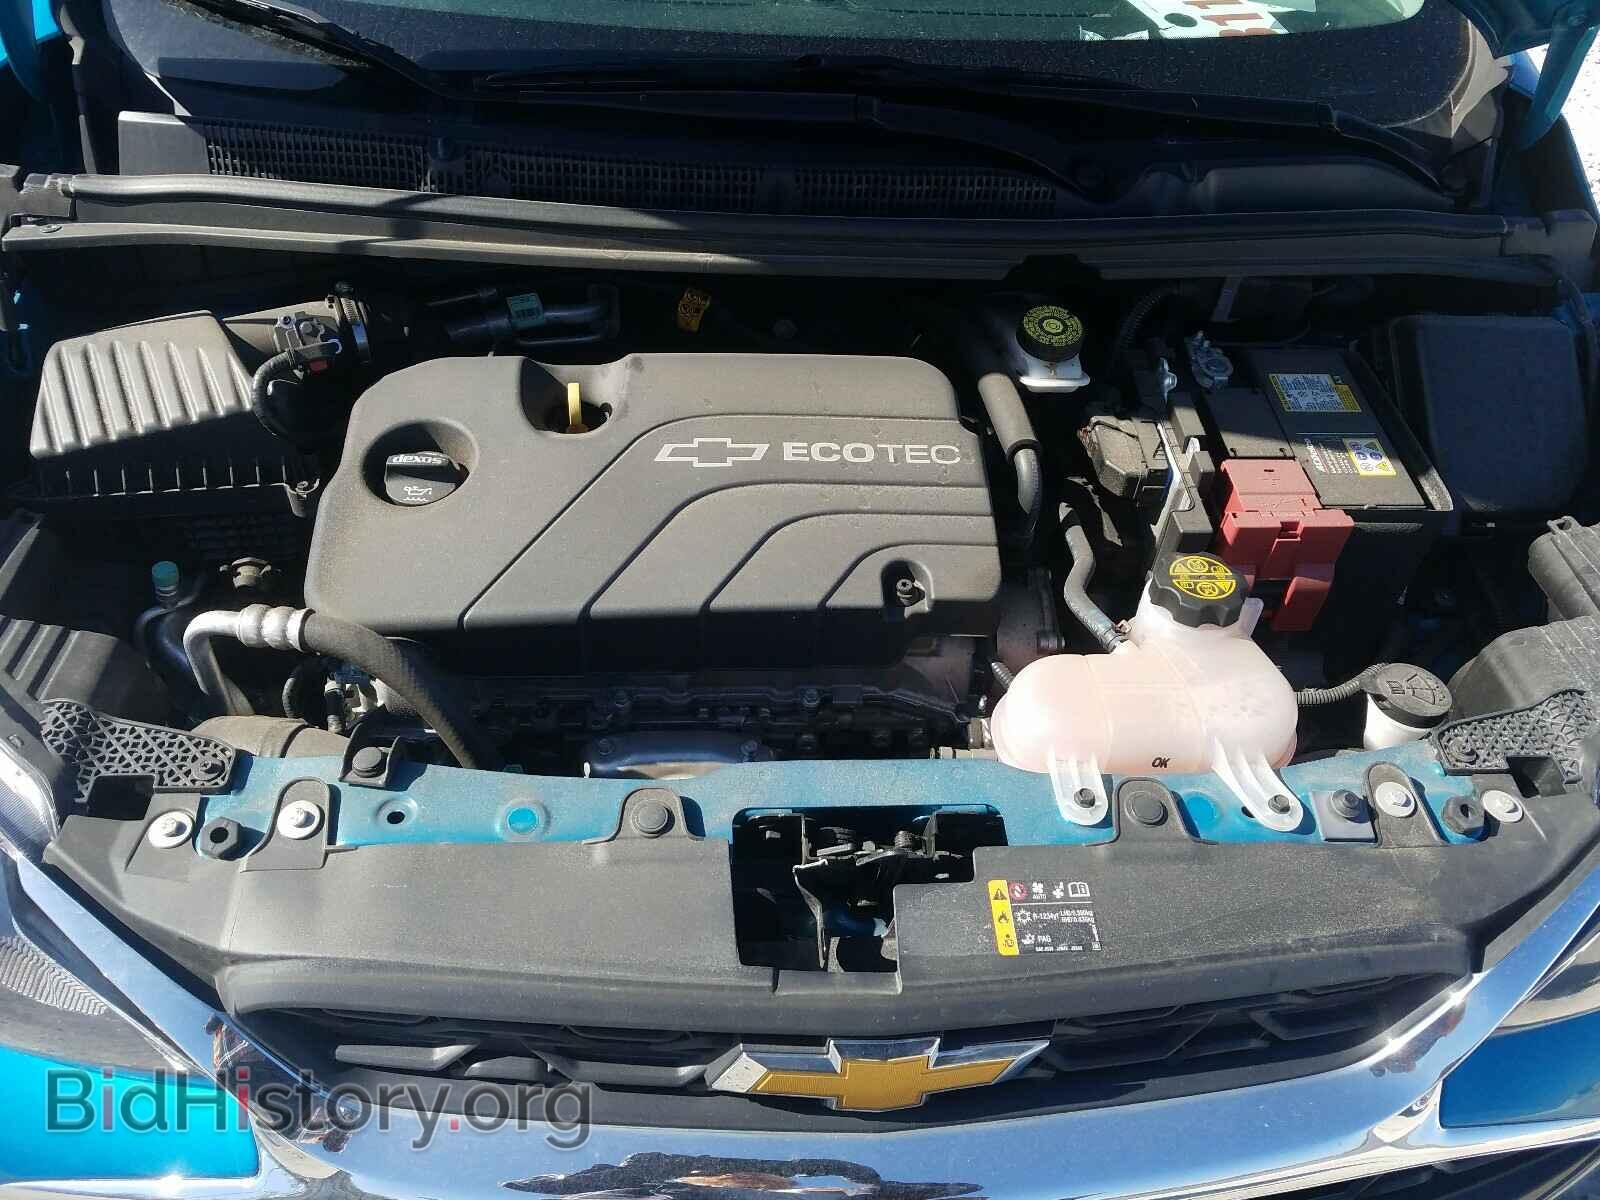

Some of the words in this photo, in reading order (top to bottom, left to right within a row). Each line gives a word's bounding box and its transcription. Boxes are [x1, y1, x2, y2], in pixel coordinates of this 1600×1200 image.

[783, 442, 961, 464] ECOTEC
[392, 454, 442, 464] dexos
[1151, 756, 1171, 768] OK
[1038, 934, 1052, 943] PAG
